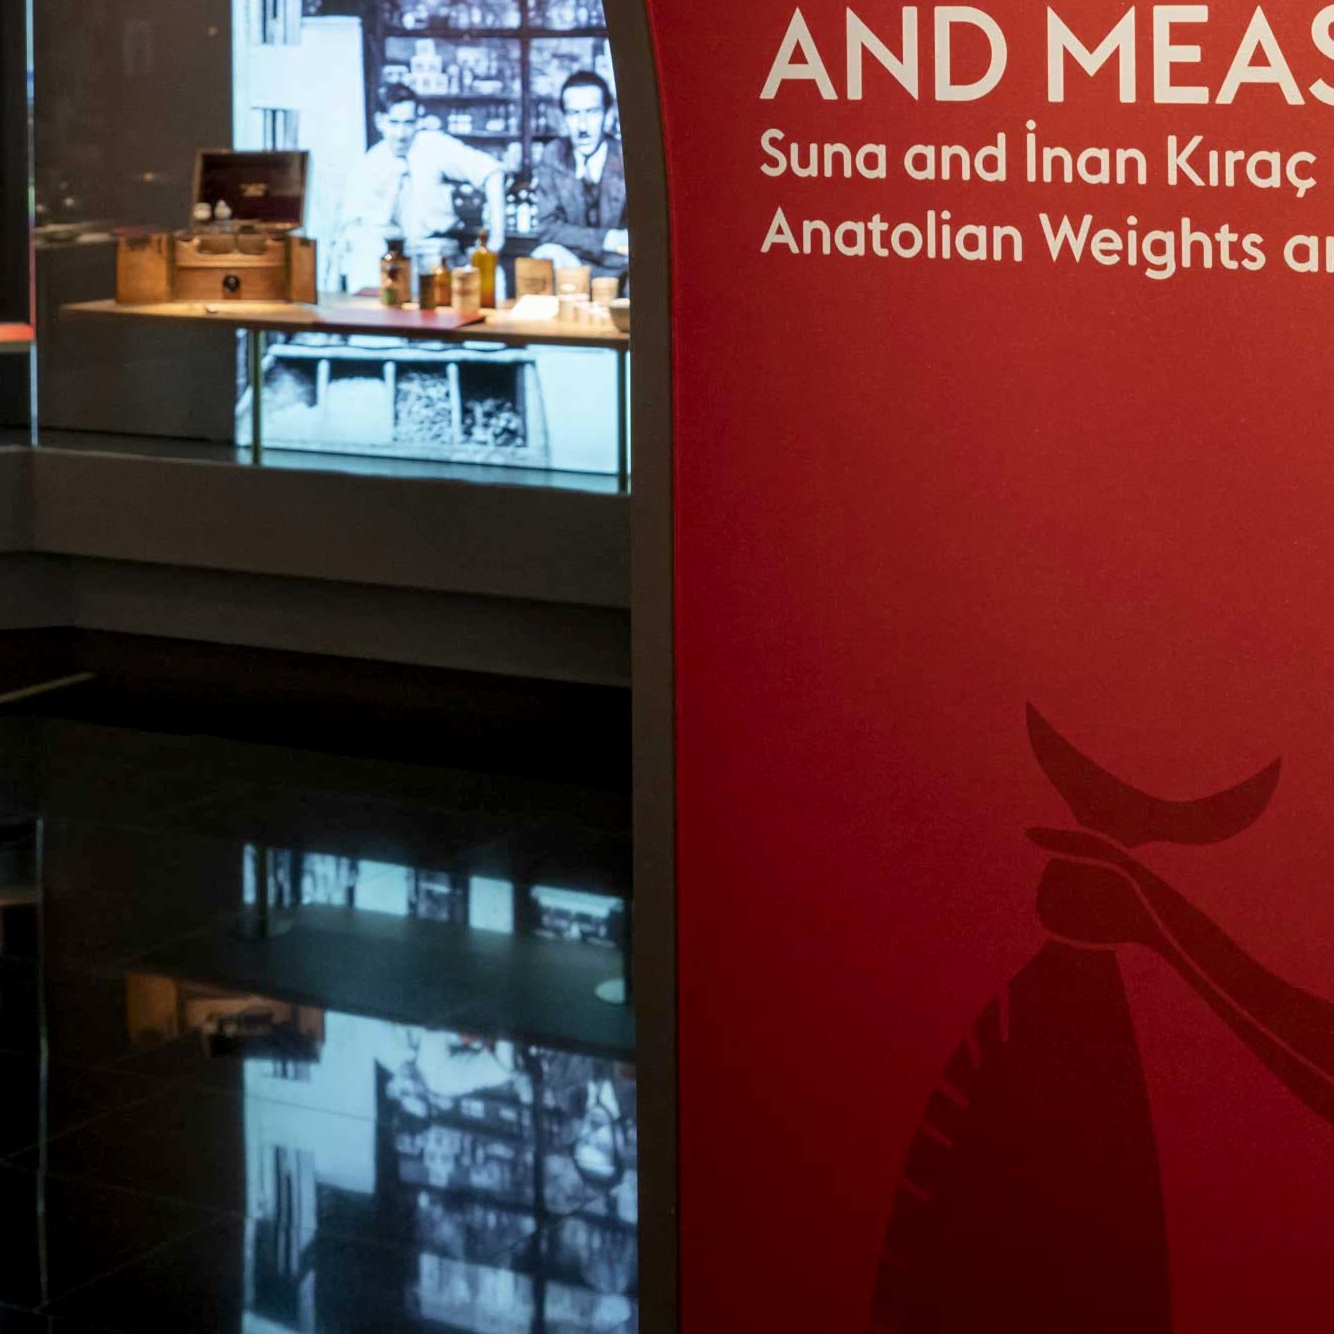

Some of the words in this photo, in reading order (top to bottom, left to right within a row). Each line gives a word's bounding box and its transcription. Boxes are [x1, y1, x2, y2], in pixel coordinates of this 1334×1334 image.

[759, 5, 1008, 102] AND
[760, 128, 887, 179] Suna
[903, 132, 1007, 182] and
[1025, 119, 1147, 185] İnan
[1167, 134, 1317, 198] Kıraç
[760, 207, 1023, 262] Anatolian
[1038, 212, 1266, 280] Weights
